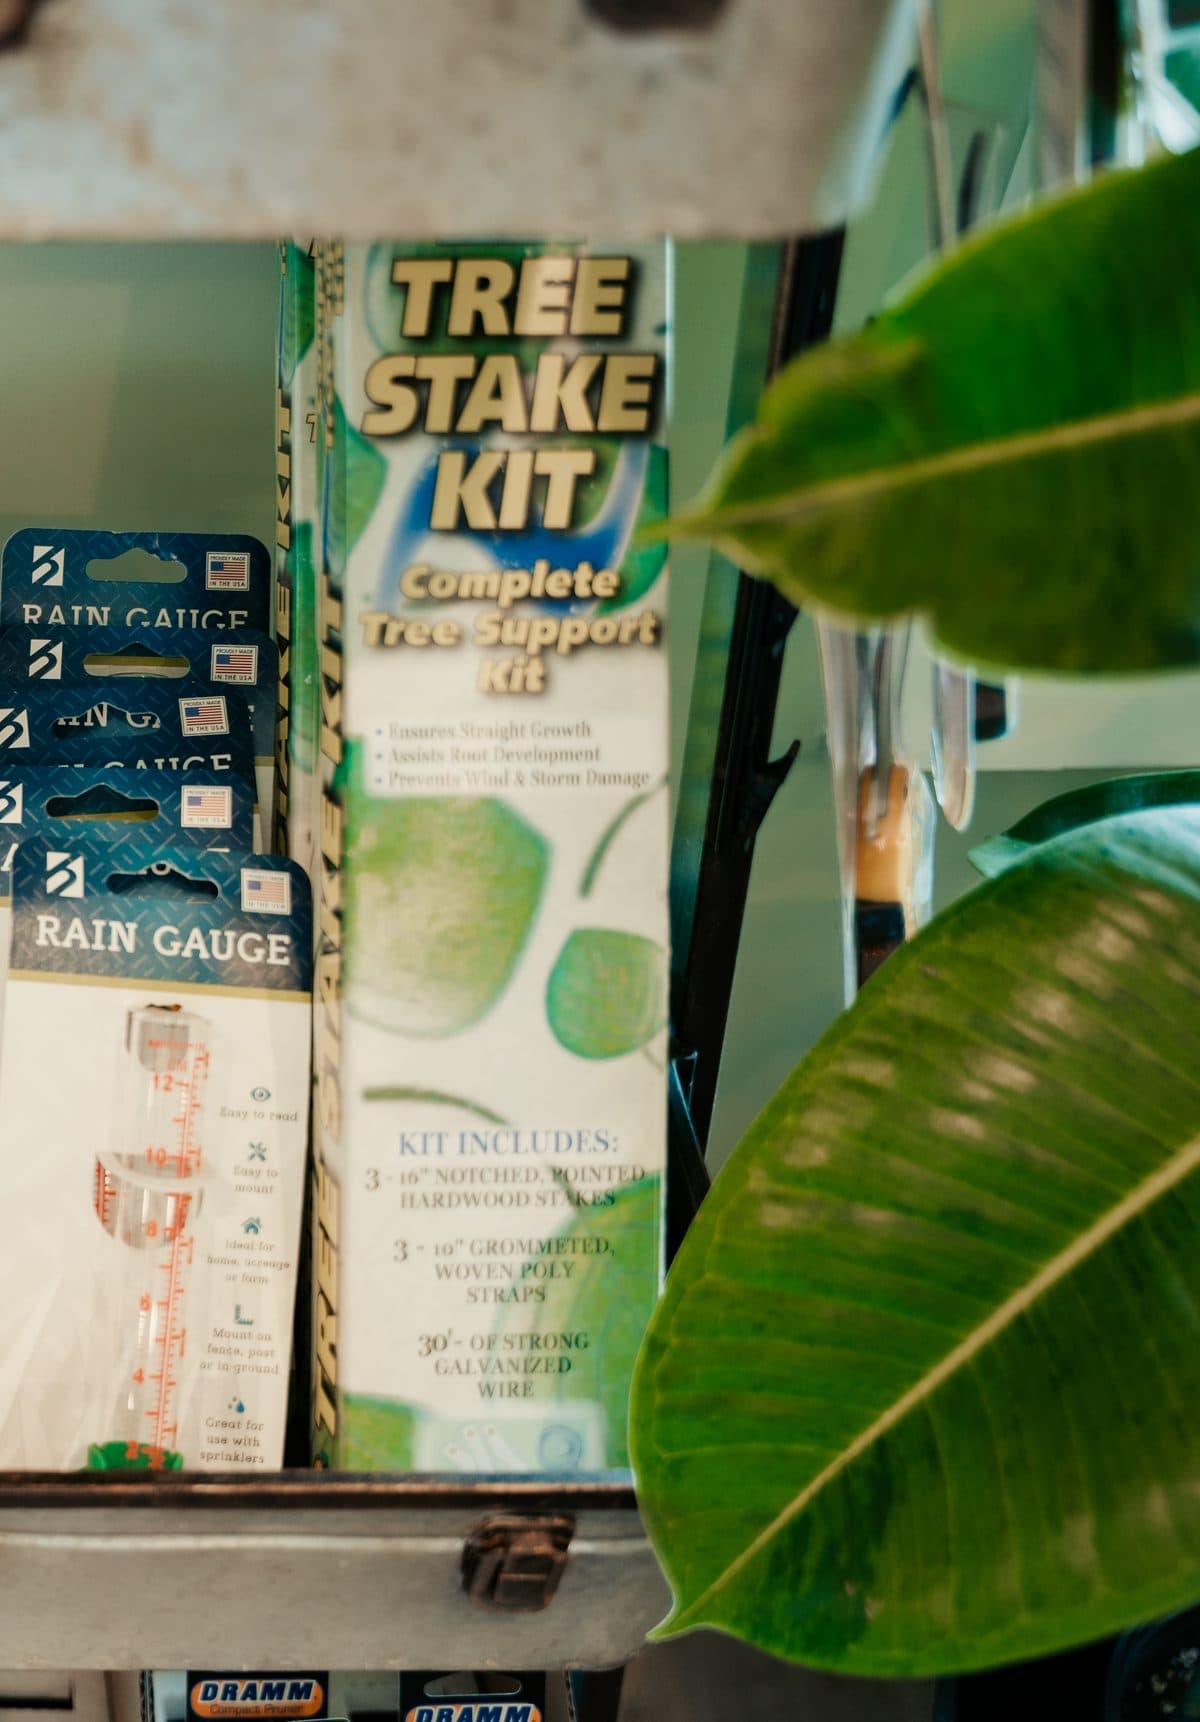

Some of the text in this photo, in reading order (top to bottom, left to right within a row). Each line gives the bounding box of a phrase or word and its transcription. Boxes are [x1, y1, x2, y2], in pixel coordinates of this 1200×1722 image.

[391, 256, 632, 337] TREE
[361, 354, 658, 436] STAKE
[430, 449, 596, 531] KIT
[400, 561, 622, 607] Complete
[23, 604, 110, 626] RAIN
[360, 609, 660, 654] Tree Support
[320, 576, 343, 767] KIT
[479, 656, 547, 696] Kit
[388, 721, 592, 743] Ensures Straight Growth
[388, 745, 601, 769] Assists Root Development
[388, 768, 651, 791] Prevents Wind & Storm Damage
[36, 915, 290, 965] RAIN GAUGE
[153, 1074, 173, 1091] 12
[220, 1107, 298, 1122] Easy to read
[399, 1129, 619, 1156] KIT INCLUDES:
[233, 1166, 278, 1178] Easy to
[365, 1168, 381, 1191] 3
[435, 1167, 544, 1186] NOTCHED,
[551, 1165, 646, 1183] POINTED
[235, 1184, 274, 1194] mount
[400, 1190, 616, 1208] HARDWOOD STAKES
[225, 1239, 275, 1251] Ideal for
[394, 1239, 408, 1261] 3
[469, 1237, 615, 1258] GROMMETED,
[245, 1259, 290, 1271] acreage
[435, 1262, 574, 1280] WOVEN POLY
[225, 1273, 269, 1284] or farm
[467, 1286, 546, 1304] STRAPS
[212, 1328, 272, 1341] Mount on
[470, 1334, 494, 1351] OF
[503, 1333, 590, 1350] STRONG
[207, 1344, 275, 1360] fence, post
[200, 1361, 213, 1370] or
[435, 1357, 572, 1376] GALVANIZED
[477, 1381, 534, 1399] WIRE
[205, 1418, 264, 1431] Great for
[207, 1436, 260, 1447] use with
[200, 1451, 264, 1465] sprinklers
[200, 1680, 318, 1702] DRAMM
[413, 1704, 535, 1722] DRAMM
